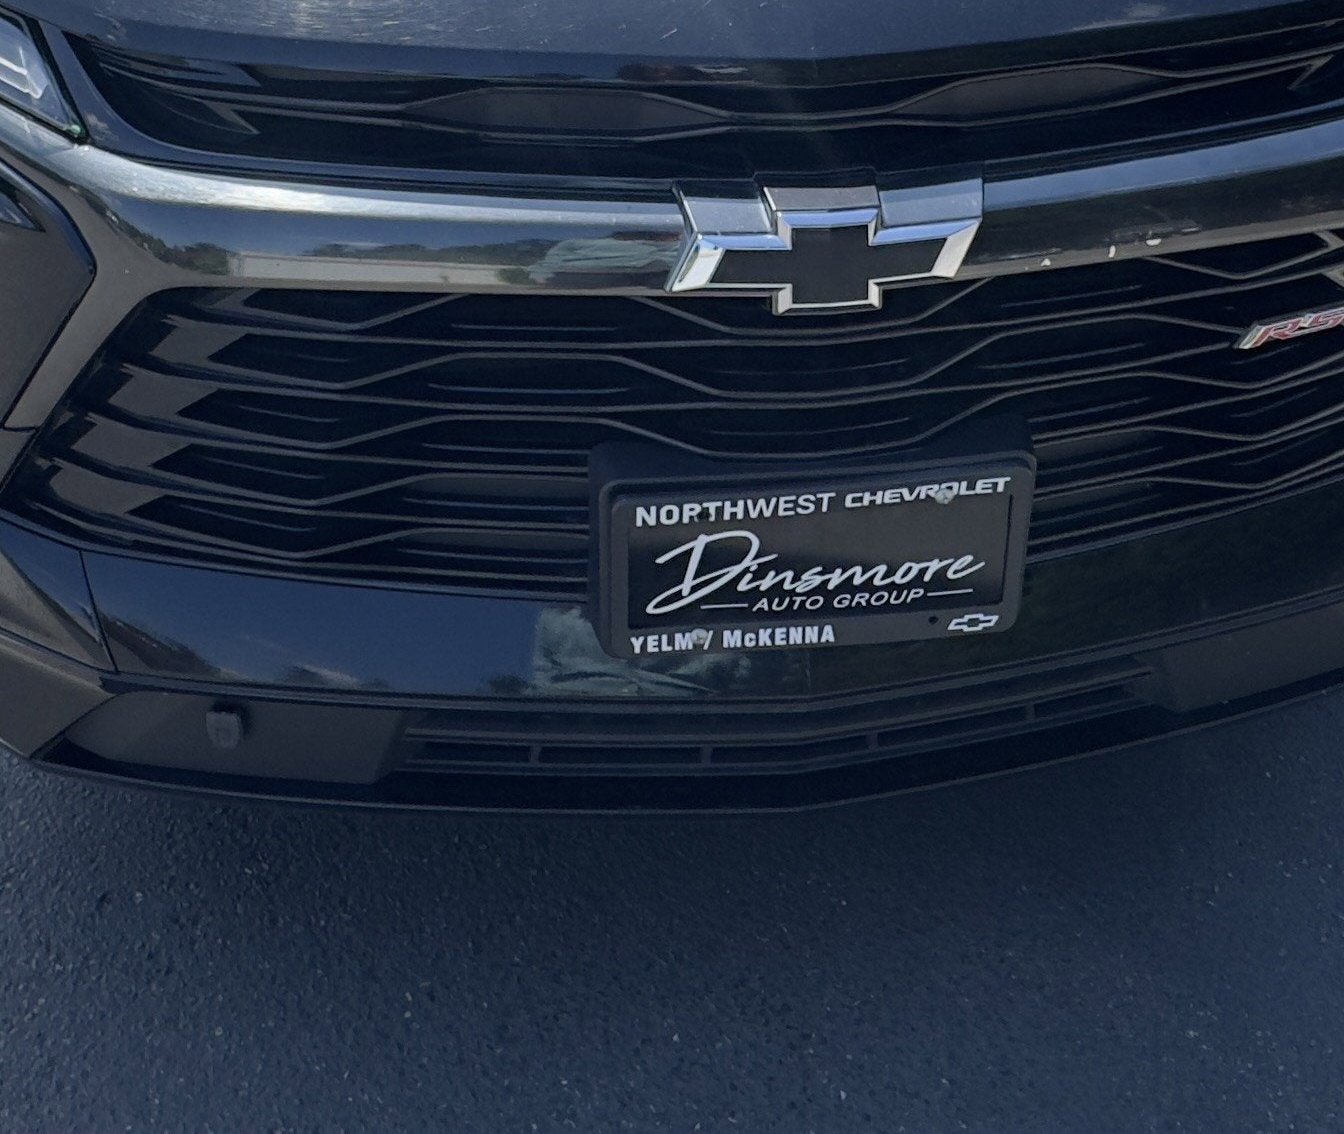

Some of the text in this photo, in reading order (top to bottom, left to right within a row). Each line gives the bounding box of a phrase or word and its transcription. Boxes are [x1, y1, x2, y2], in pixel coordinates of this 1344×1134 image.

[635, 476, 1011, 527] NORTHWEST CHEVROLET
[645, 530, 985, 615] Dinsmore
[752, 588, 925, 612] AUTO GROUP
[630, 632, 693, 654] YELM
[722, 624, 835, 648] McKENNA
